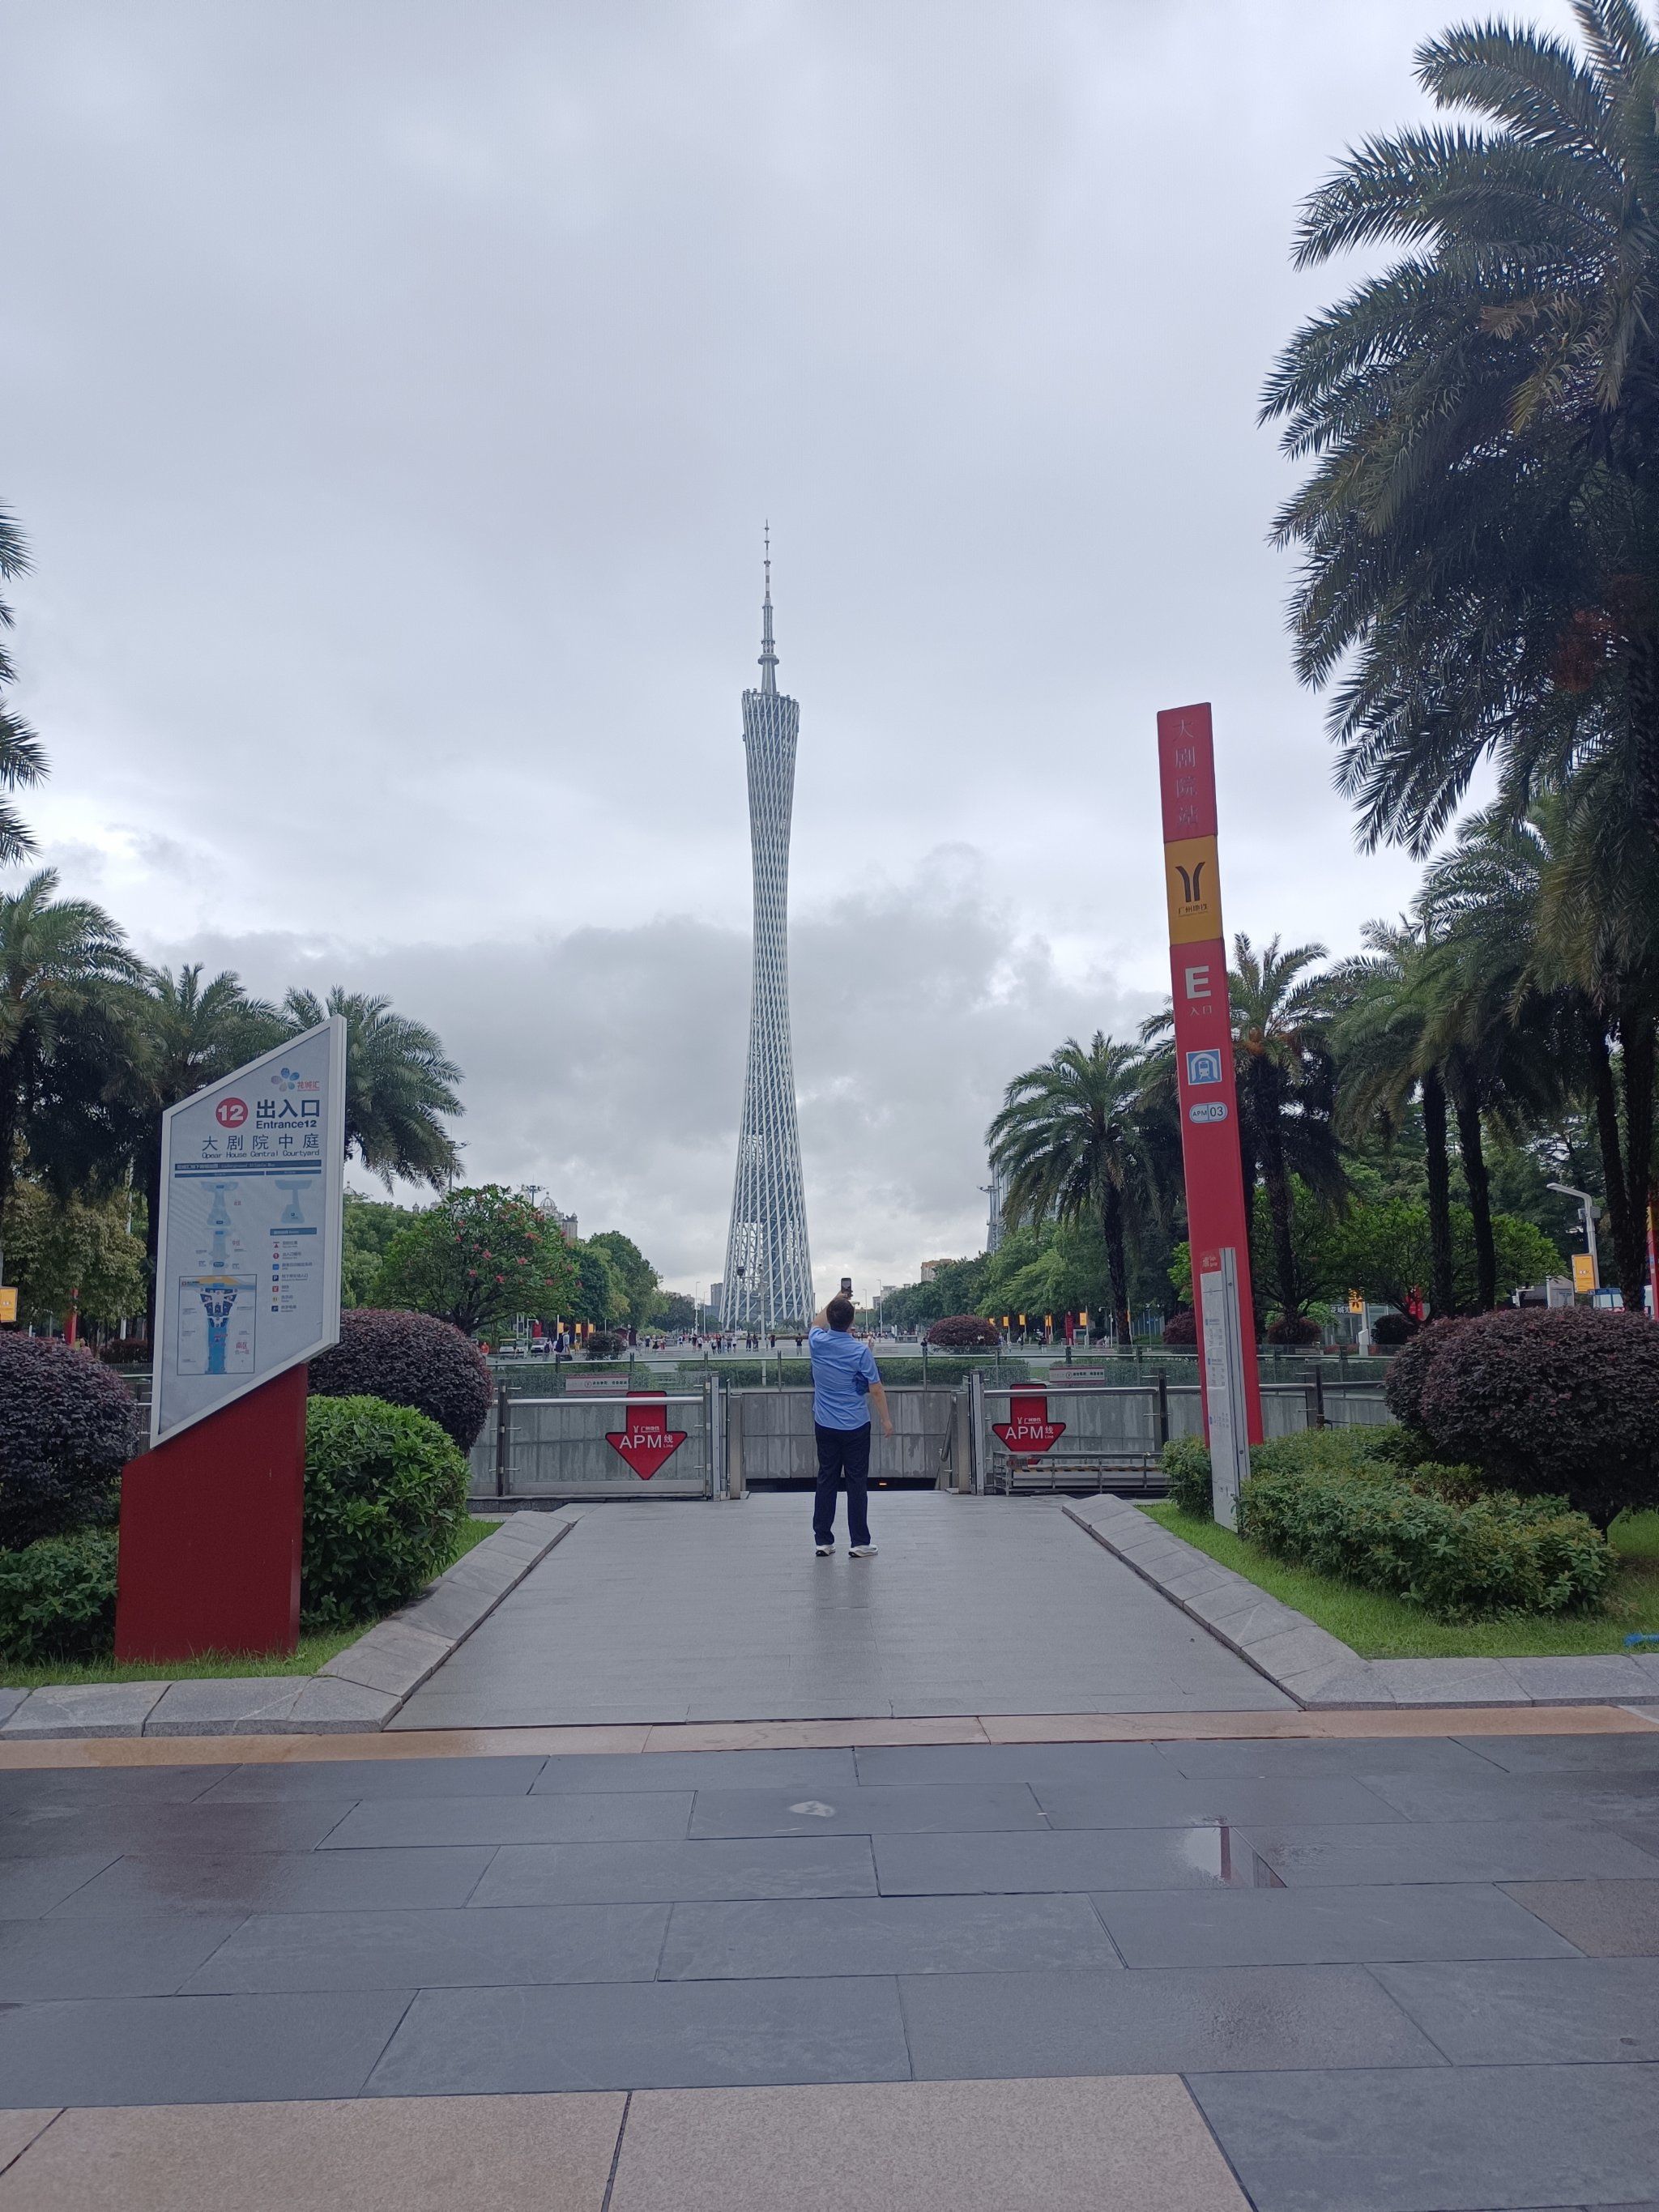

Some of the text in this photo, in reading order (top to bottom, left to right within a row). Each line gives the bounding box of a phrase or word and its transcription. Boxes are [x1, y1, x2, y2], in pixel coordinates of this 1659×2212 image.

[1185, 965, 1211, 999] E
[1190, 1005, 1212, 1016] 入口
[218, 1105, 243, 1122] 12
[256, 1099, 320, 1119] 出入口
[1192, 1106, 1223, 1117] APM 03
[256, 1120, 317, 1129] Entrance12
[202, 1133, 319, 1151] 大剧院中庭
[283, 1149, 320, 1157] Courtyard
[1005, 1426, 1053, 1439] APM 线
[619, 1434, 673, 1449] APM 线
